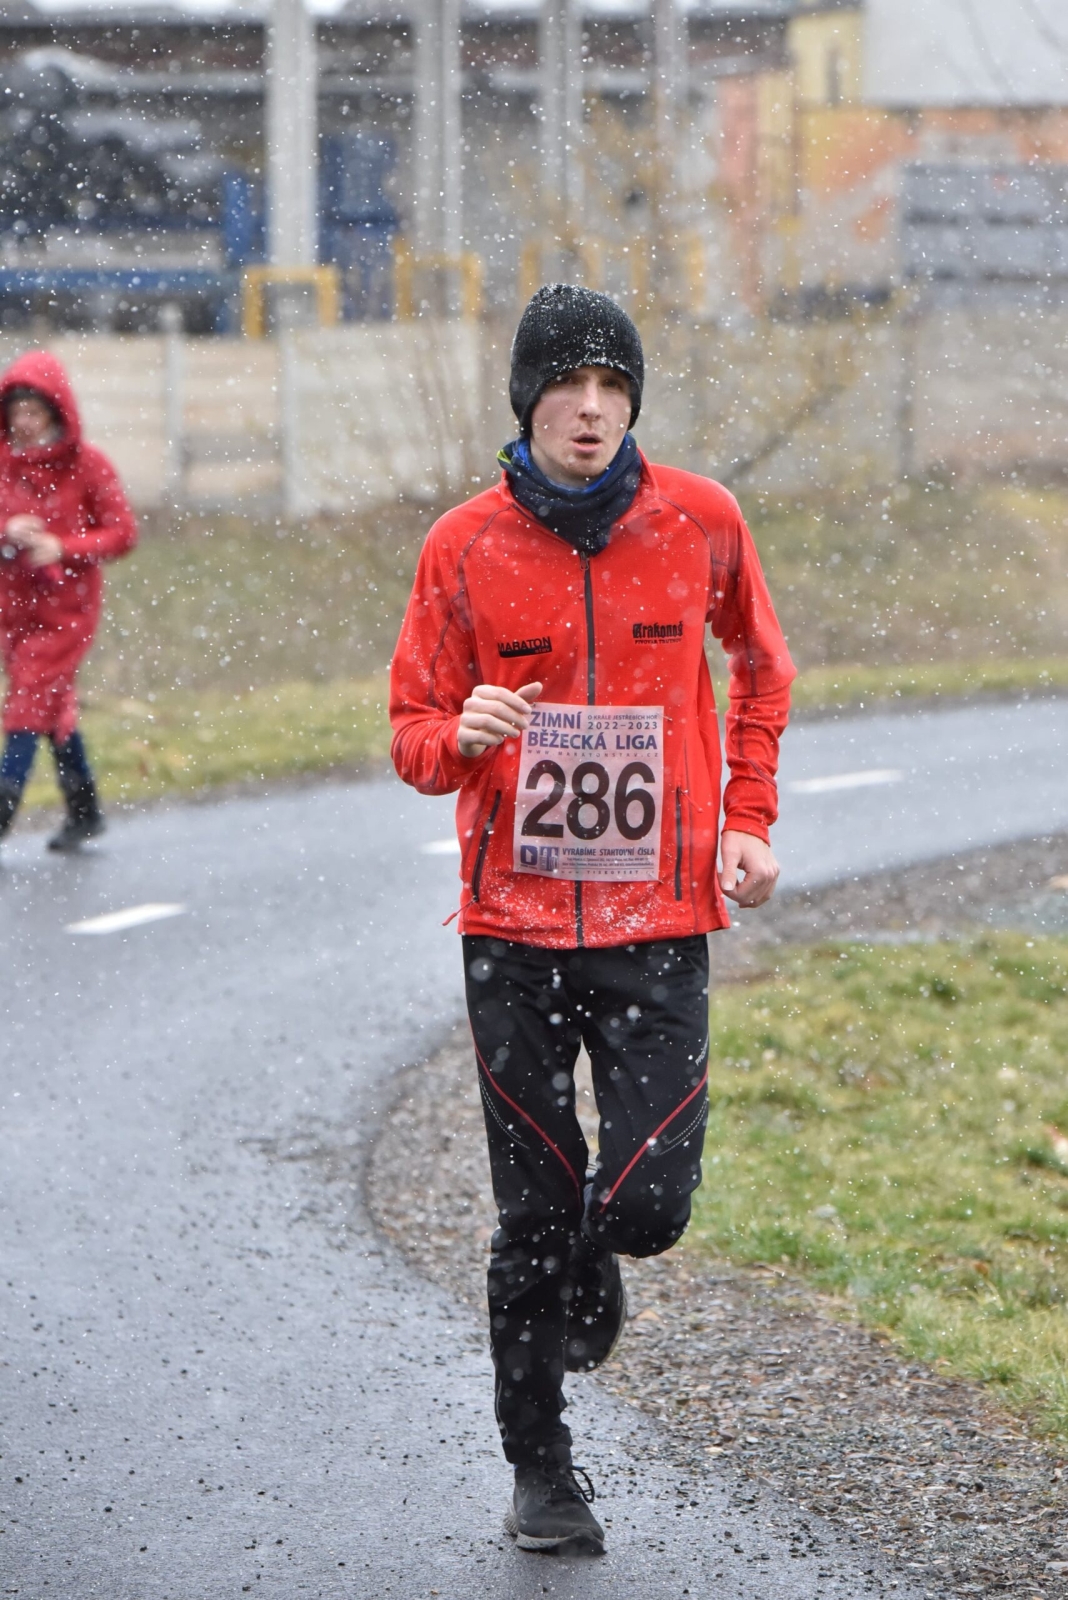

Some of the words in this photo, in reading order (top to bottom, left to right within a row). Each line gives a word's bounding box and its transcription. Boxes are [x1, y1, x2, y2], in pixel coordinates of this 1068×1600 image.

[497, 636, 551, 652] MARATON
[529, 711, 582, 729] ZIMNÍ
[527, 729, 606, 750] BĚŽECKÁ
[616, 734, 657, 750] LIGA
[520, 759, 656, 840] 286
